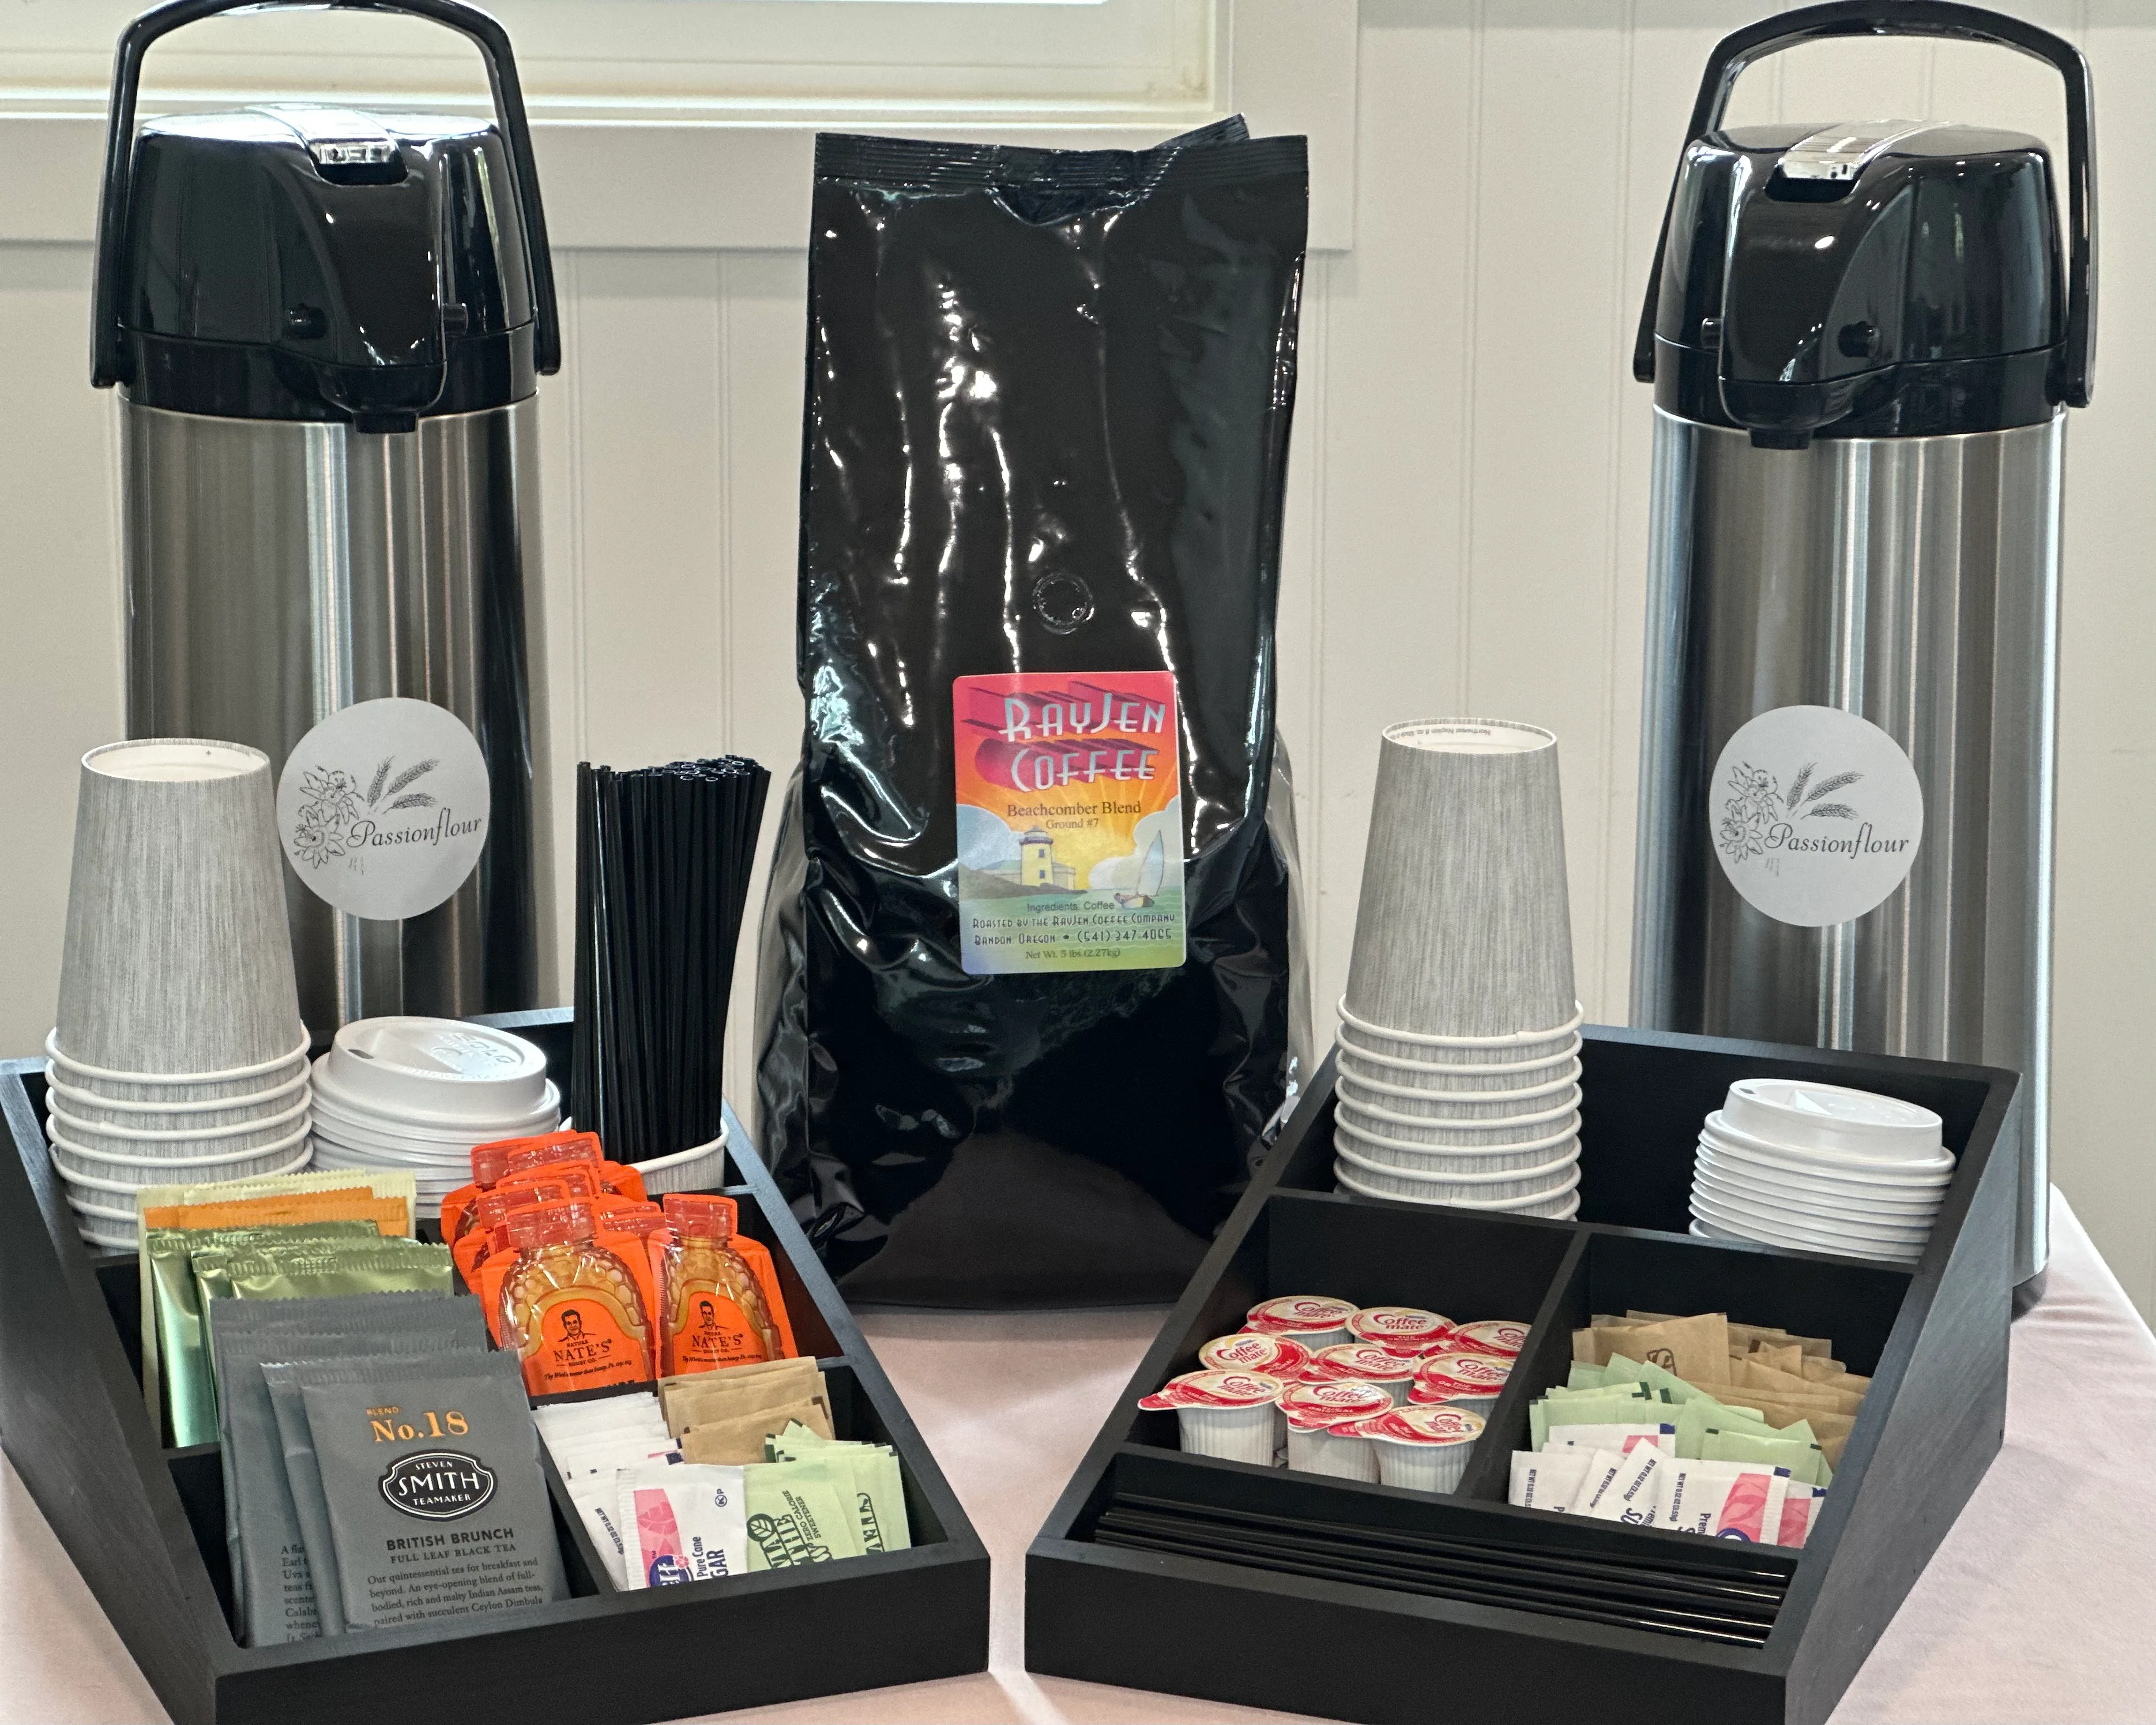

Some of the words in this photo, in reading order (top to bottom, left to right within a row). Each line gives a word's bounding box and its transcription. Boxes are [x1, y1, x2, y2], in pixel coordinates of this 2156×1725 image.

[1011, 749, 1158, 792] COFFEE
[1007, 802, 1097, 817] Beachcomber
[1102, 801, 1141, 814] Blend
[346, 807, 482, 848] Passionflour
[1046, 818, 1083, 829] Ground
[1086, 818, 1099, 828] #7
[1764, 822, 1909, 859] Passionflour
[1084, 901, 1115, 910] Coffee
[973, 918, 1013, 929] ROASTED
[1032, 918, 1048, 926] THE
[1092, 914, 1128, 924] COFFEE
[1018, 934, 1055, 944] OREGON
[1077, 930, 1111, 942] (541)
[1374, 1314, 1427, 1325] Coffee
[553, 1340, 611, 1362] NATE'S
[692, 1334, 742, 1348] NATE'S
[1217, 1343, 1259, 1361] Coffee
[366, 1406, 399, 1415] BLEND
[370, 1411, 468, 1442] No.18
[415, 1461, 453, 1471] STEVEN
[398, 1472, 480, 1496] SMITH
[412, 1494, 471, 1506] TEAMAKER
[782, 1490, 803, 1519] CALORIE
[795, 1496, 821, 1539] SWEETENER
[386, 1535, 445, 1550] BRITISH
[451, 1528, 514, 1544] BRUNCH
[800, 1521, 814, 1540] ZERO
[281, 1546, 289, 1554] A
[390, 1555, 419, 1564] FULL
[423, 1551, 450, 1560] LEAF
[455, 1547, 491, 1557] BLACK
[494, 1543, 516, 1552] TEA
[692, 1536, 703, 1557] Cane
[281, 1558, 302, 1566] Earl
[367, 1575, 386, 1585] Our
[389, 1566, 450, 1584] quintessential
[467, 1563, 479, 1573] for
[481, 1559, 520, 1570] breakfast
[523, 1558, 538, 1567] and
[697, 1558, 709, 1578] Pure
[423, 1579, 477, 1592] eye-opening
[479, 1574, 503, 1584] blend
[506, 1573, 515, 1581] of
[517, 1570, 535, 1580] full-
[407, 1599, 423, 1607] rich
[425, 1596, 441, 1604] and
[443, 1593, 466, 1604] malty
[468, 1589, 495, 1599] Indian
[497, 1587, 523, 1596] Assam
[405, 1611, 425, 1621] with
[427, 1606, 469, 1618] succulent
[471, 1602, 503, 1613] Ceylon
[506, 1596, 543, 1608] Dimbula
